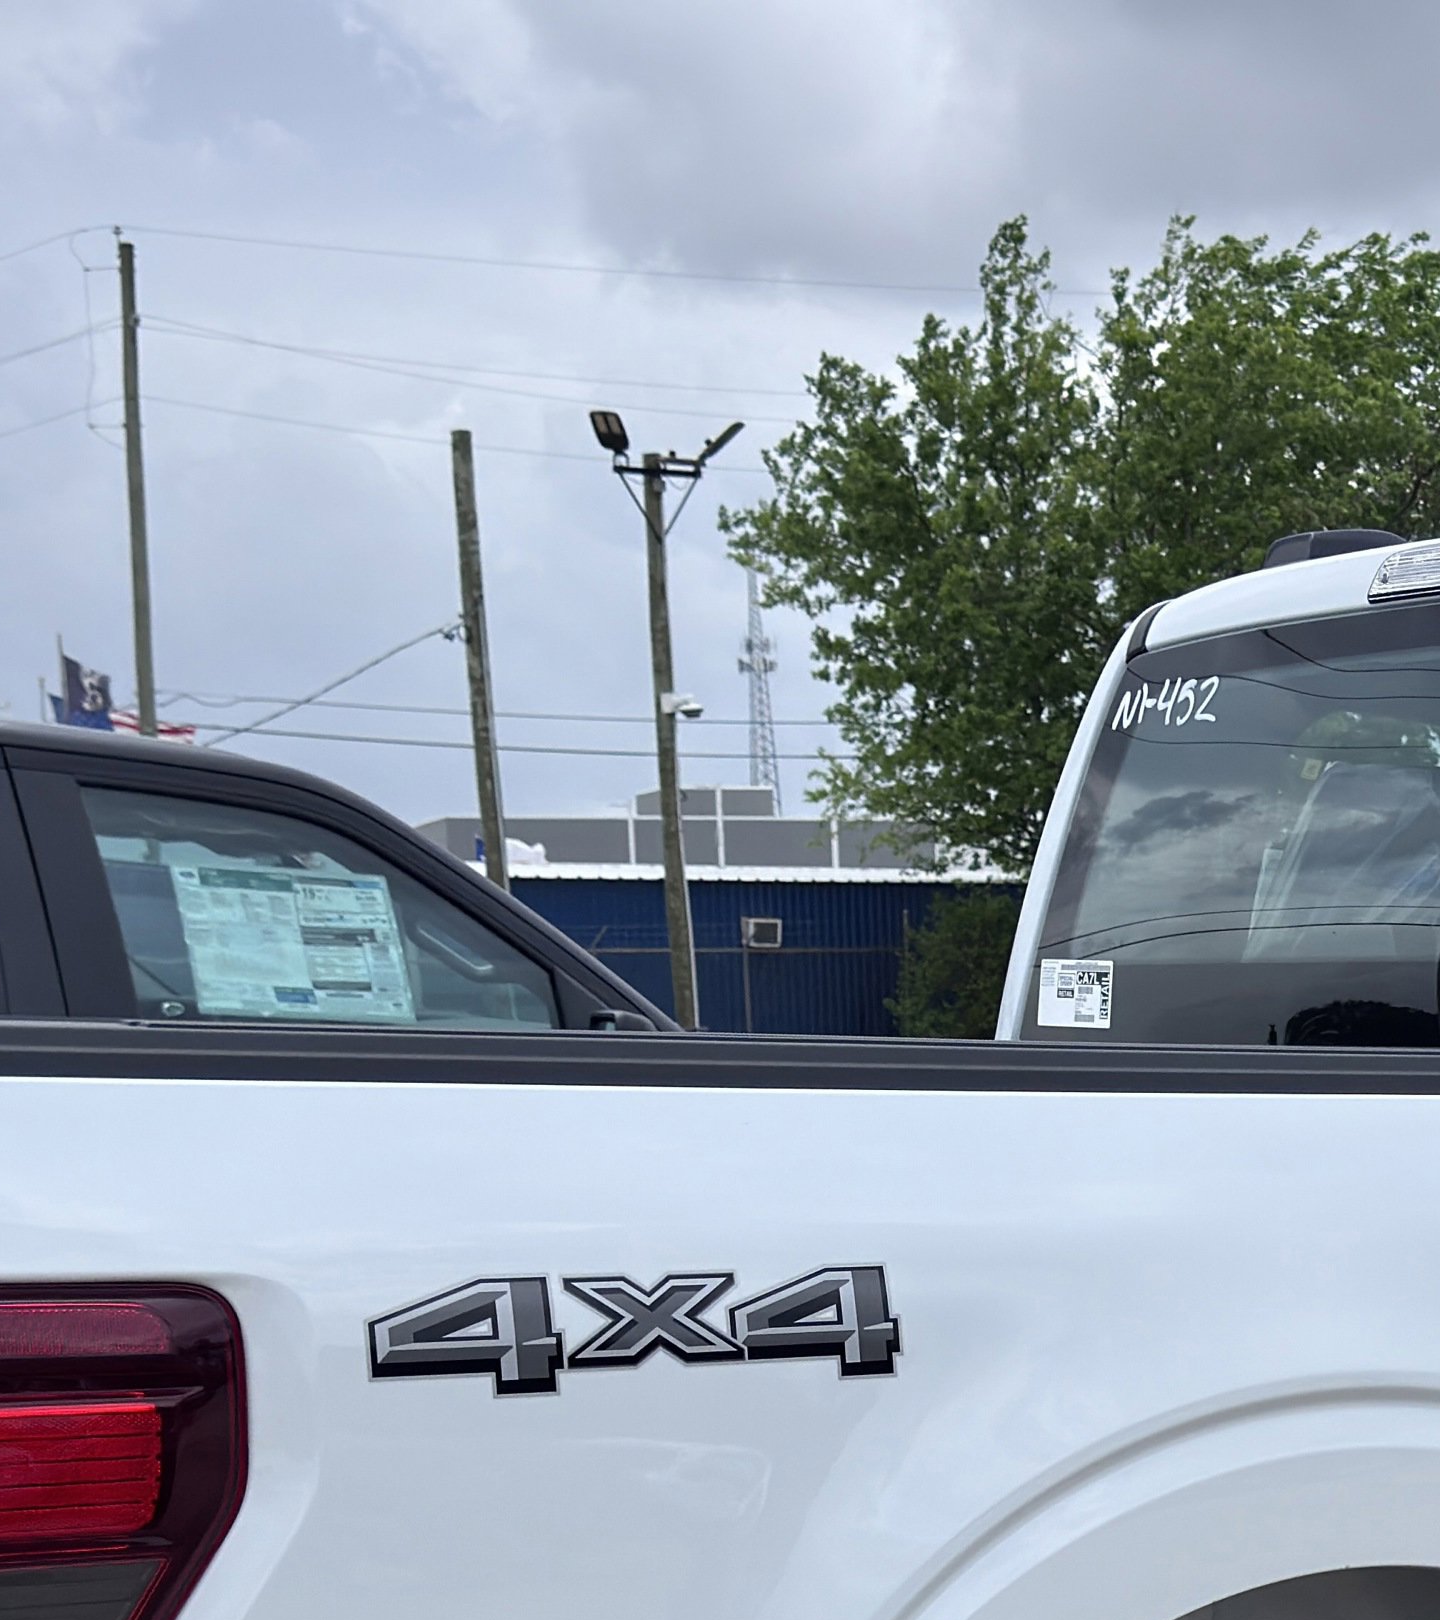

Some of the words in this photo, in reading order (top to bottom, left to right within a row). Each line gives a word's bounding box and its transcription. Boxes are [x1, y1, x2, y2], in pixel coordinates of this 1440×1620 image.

[1076, 972, 1100, 985] CA7L
[1100, 974, 1110, 1019] RETAIL
[364, 1262, 902, 1399] 4X4
